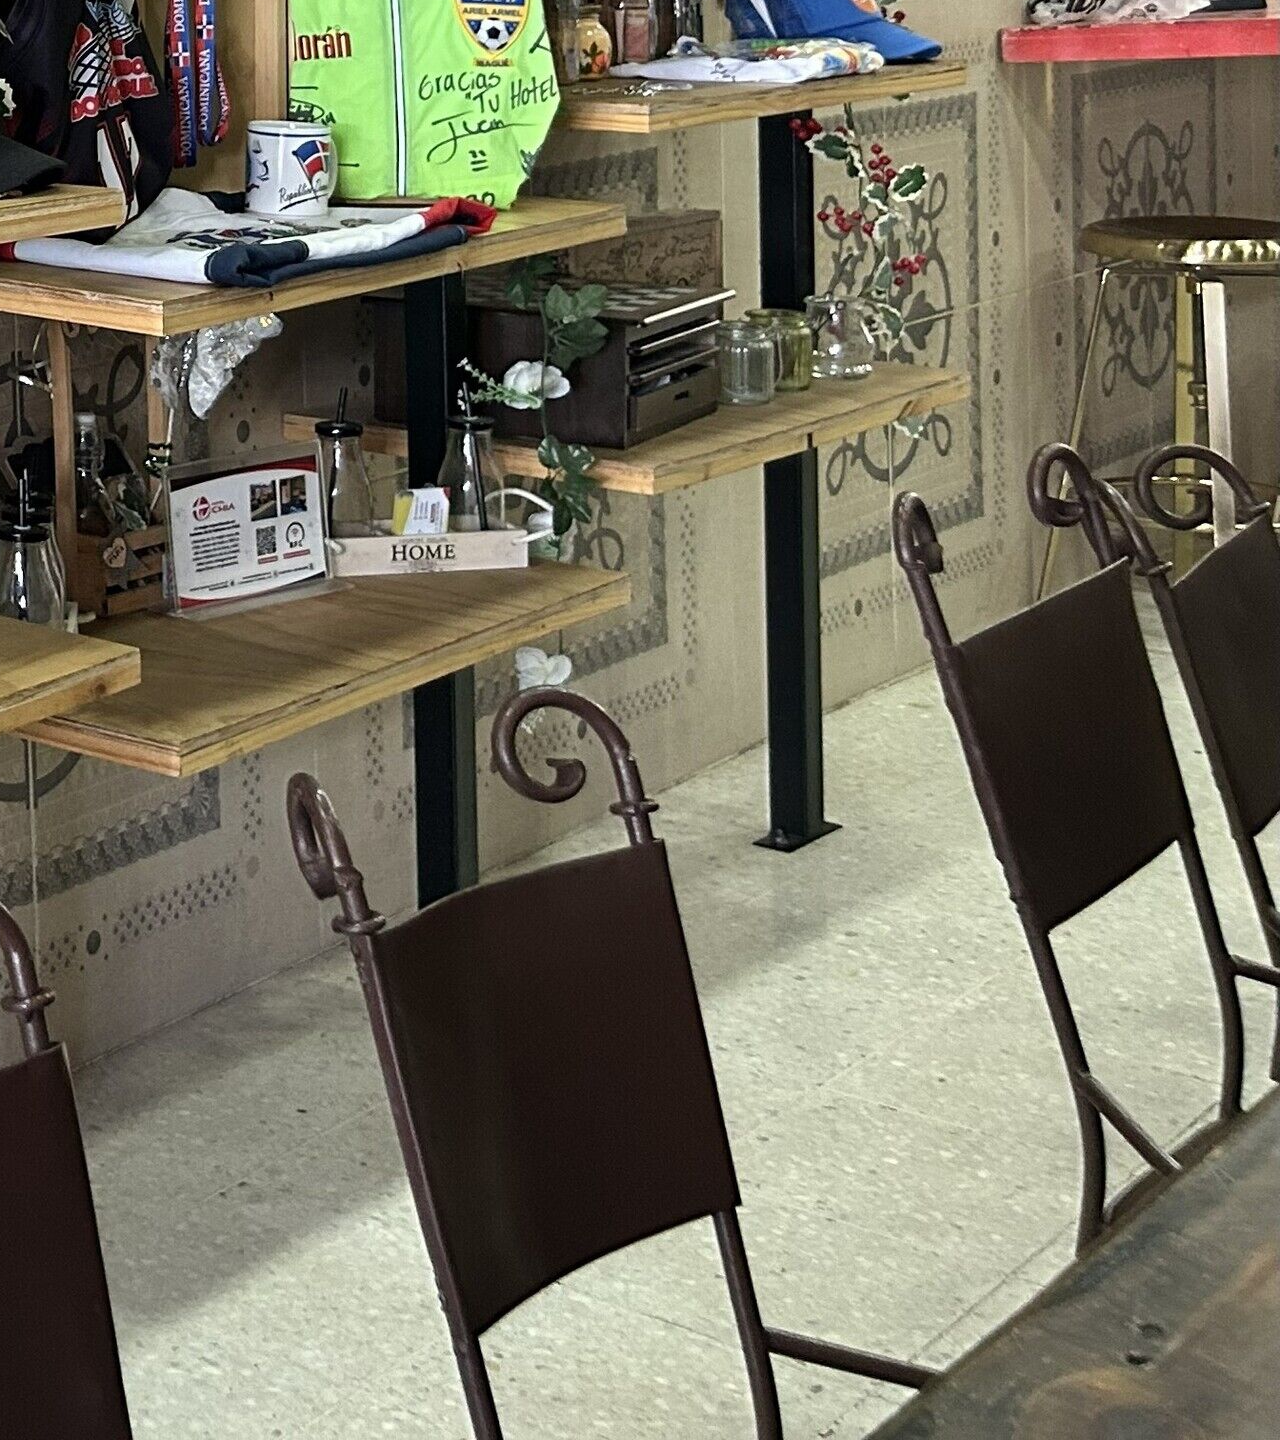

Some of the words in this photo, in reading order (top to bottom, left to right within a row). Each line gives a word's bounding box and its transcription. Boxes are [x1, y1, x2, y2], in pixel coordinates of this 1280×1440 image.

[198, 47, 211, 133] DOMINICANA
[418, 71, 502, 101] Gracias
[180, 75, 192, 158] DOMINICANA
[391, 544, 456, 561] HOME
